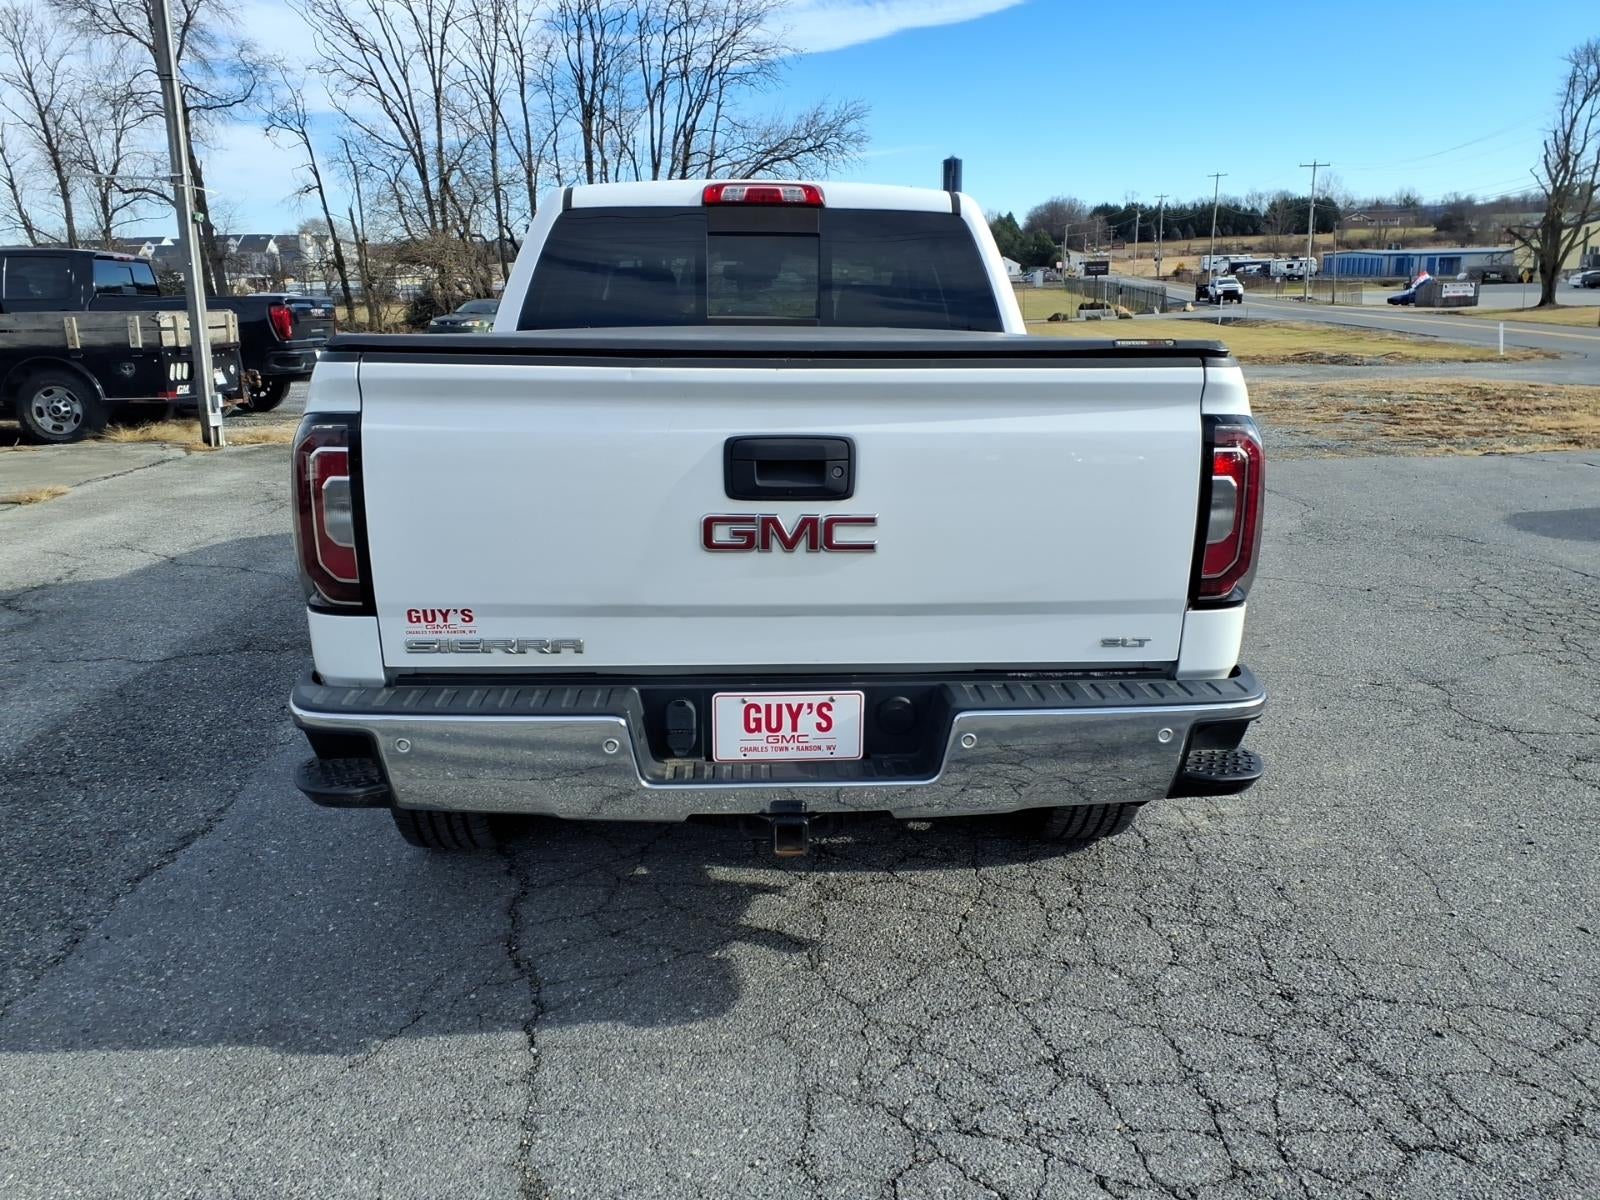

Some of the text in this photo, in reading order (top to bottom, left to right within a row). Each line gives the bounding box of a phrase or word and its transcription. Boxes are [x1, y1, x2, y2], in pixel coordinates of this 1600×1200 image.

[700, 513, 880, 553] GMC
[406, 608, 474, 624] GUY'S
[404, 638, 585, 655] SIERRA
[1100, 637, 1152, 648] SLT
[743, 702, 834, 734] GUY'S
[766, 734, 809, 744] GMC
[739, 745, 769, 753] CHARLES
[795, 744, 824, 753] RANSON,
